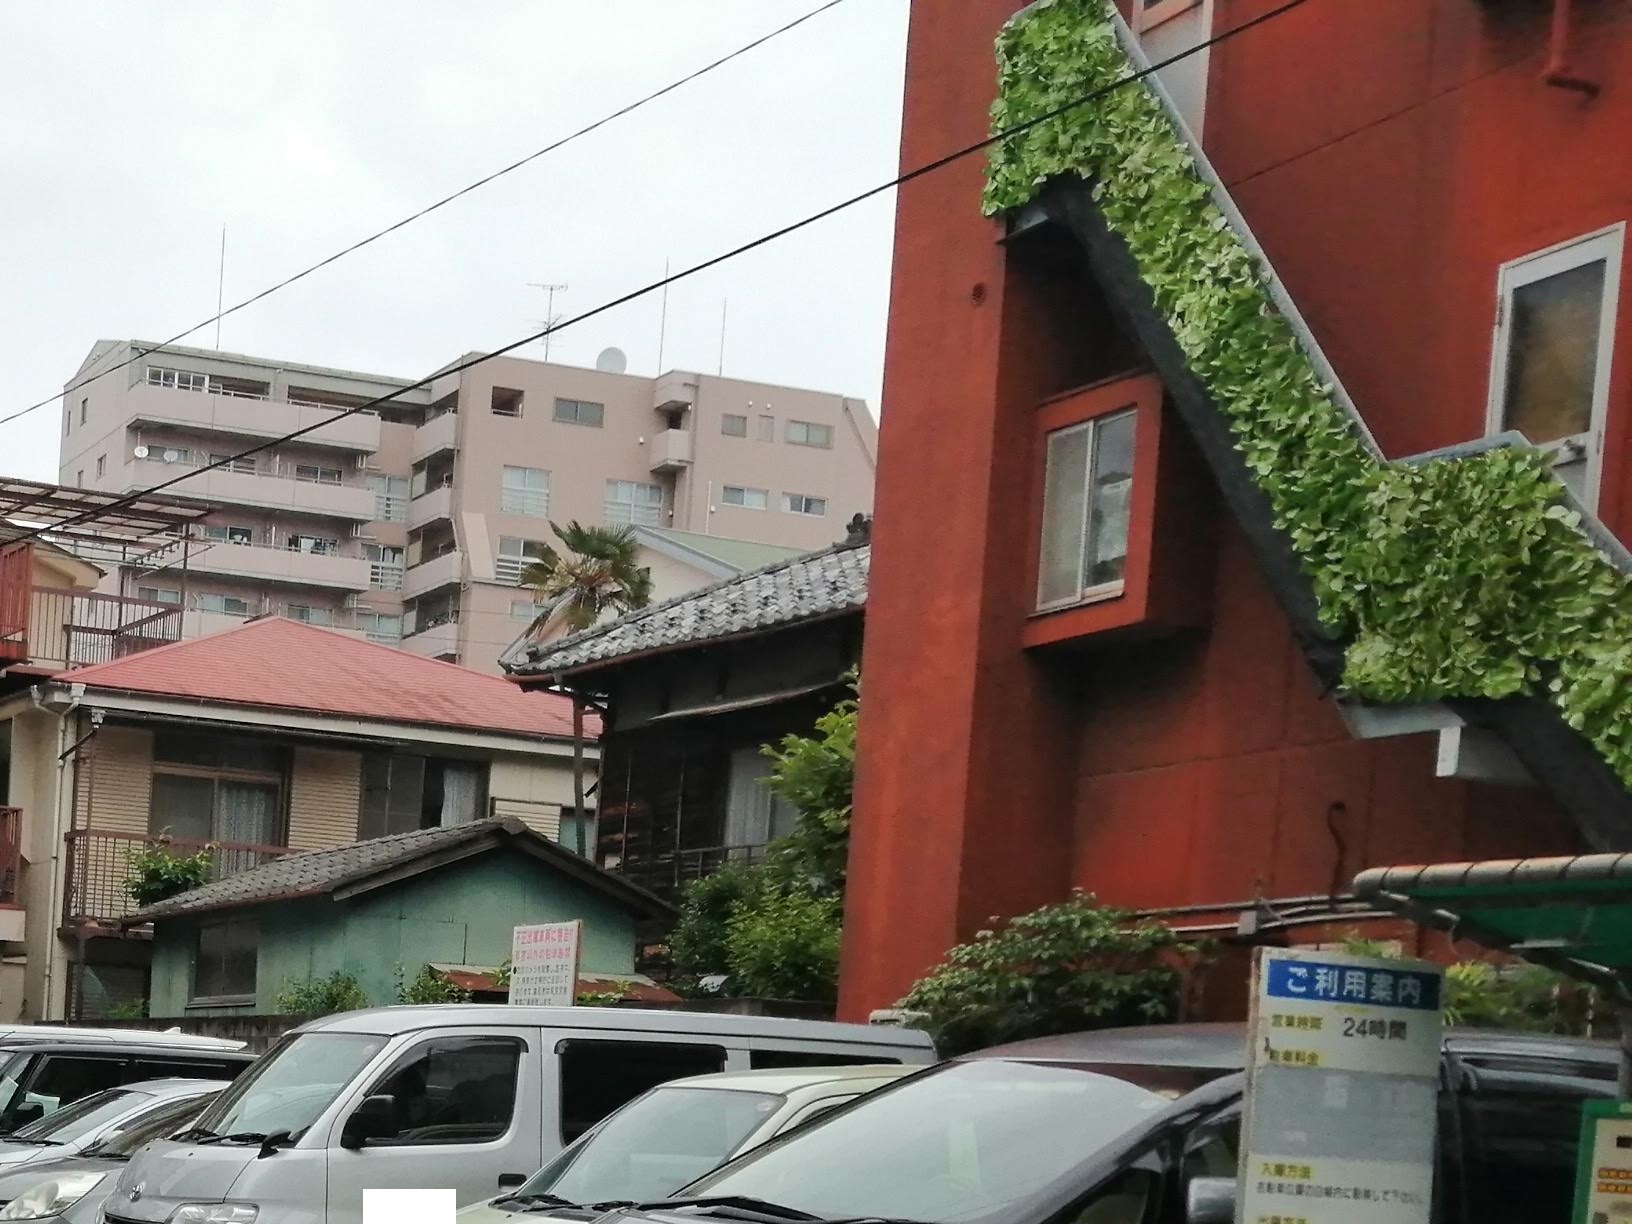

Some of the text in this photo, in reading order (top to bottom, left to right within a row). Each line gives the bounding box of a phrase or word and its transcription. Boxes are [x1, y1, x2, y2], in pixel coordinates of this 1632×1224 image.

[1287, 967, 1422, 1004] ご利用案内
[1342, 1017, 1408, 1040] 24時間
